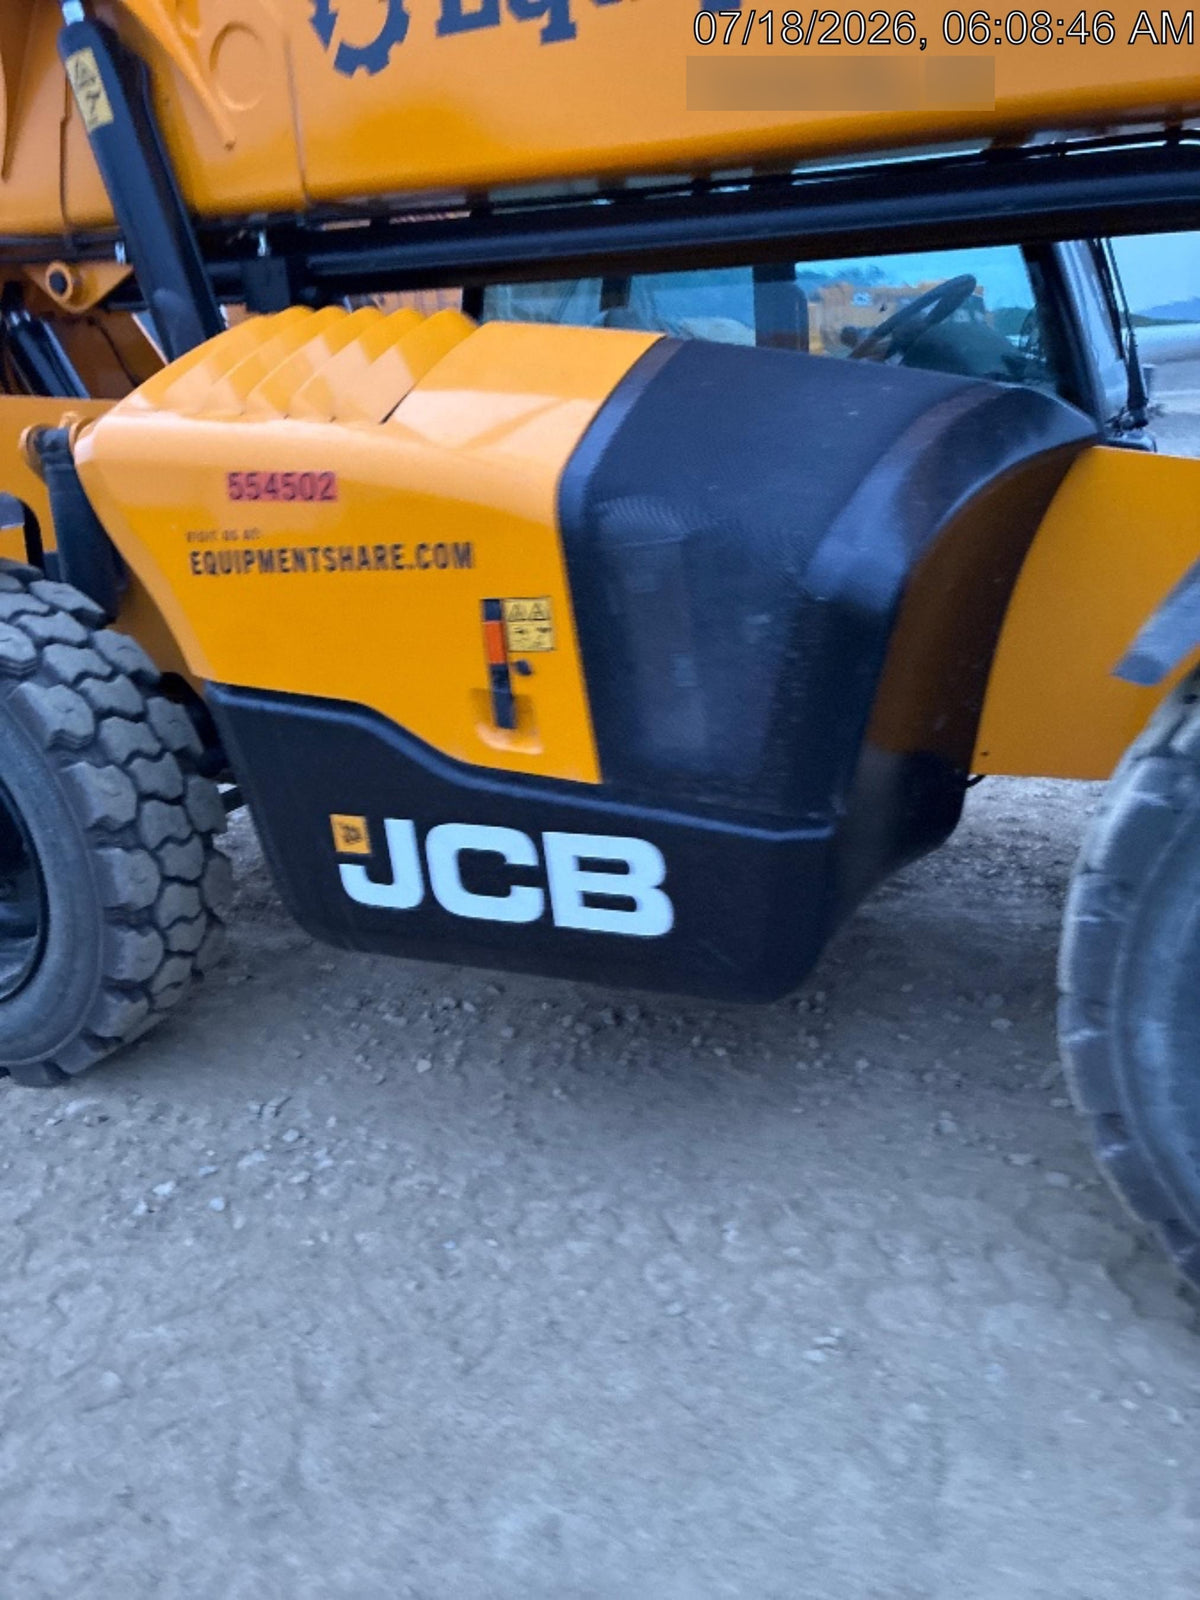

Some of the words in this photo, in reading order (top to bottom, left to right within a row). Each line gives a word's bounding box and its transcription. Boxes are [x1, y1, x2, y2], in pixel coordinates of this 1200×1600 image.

[228, 472, 337, 501] 554502
[190, 542, 474, 575] EQUIPMENTSHARE.COM
[337, 817, 675, 937] JCB
